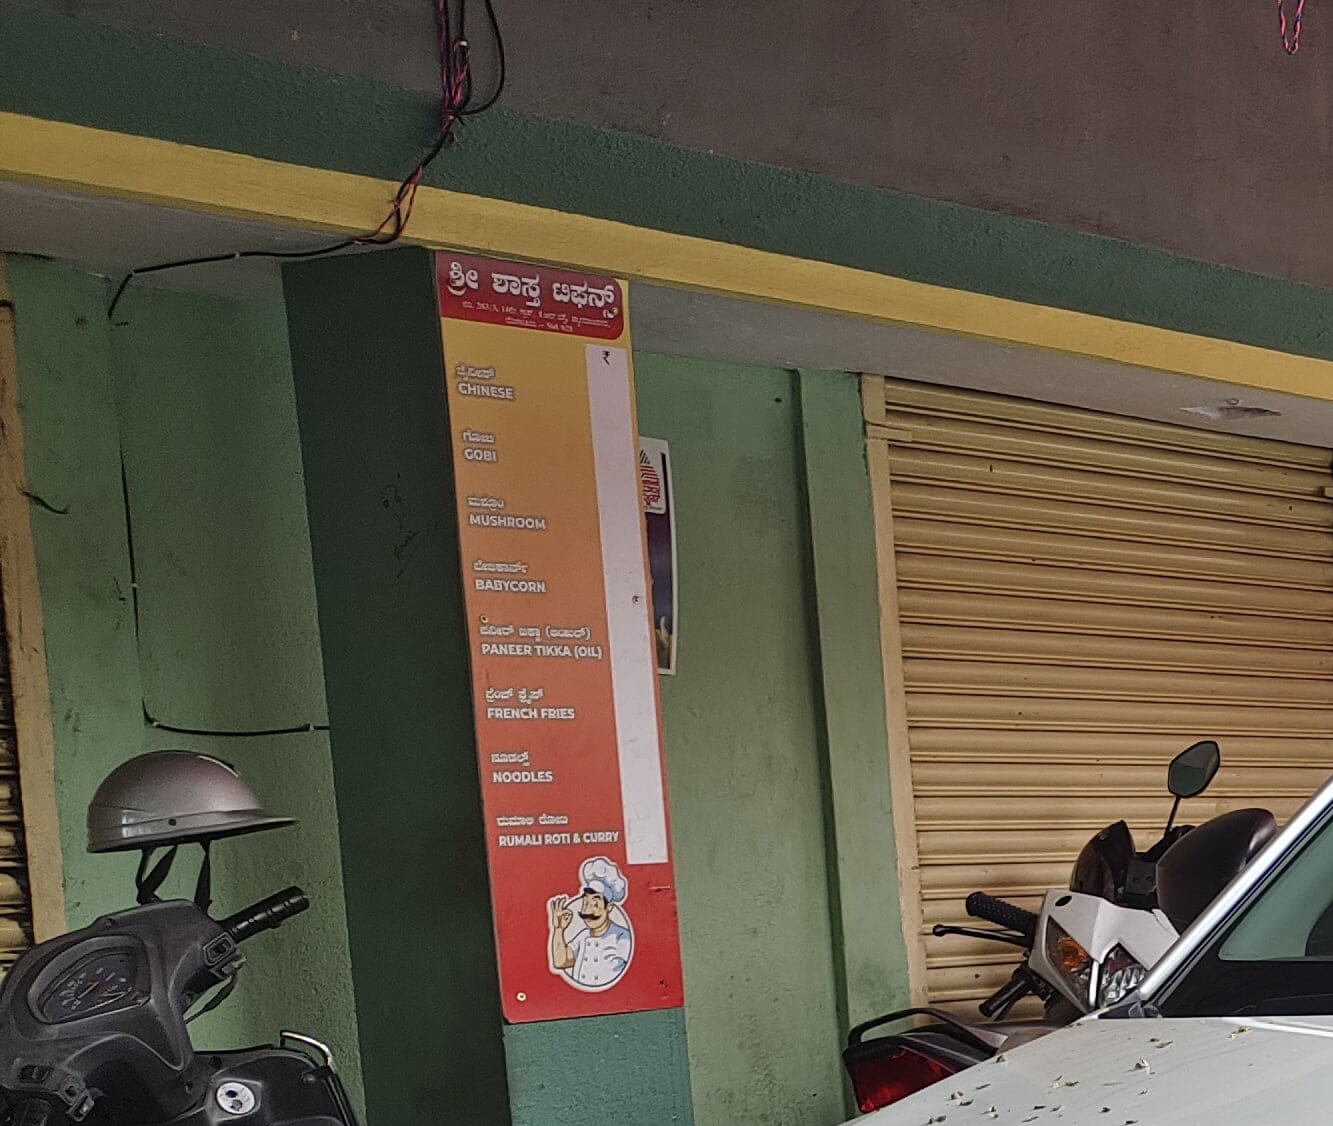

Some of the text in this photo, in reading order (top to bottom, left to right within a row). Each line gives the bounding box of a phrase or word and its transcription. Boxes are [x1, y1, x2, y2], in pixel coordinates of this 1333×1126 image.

[447, 261, 480, 296] ಶ್ರೀ
[458, 383, 514, 399] CHINESE
[464, 449, 497, 462] GOBI
[469, 514, 546, 530] MUSHROOM
[475, 579, 546, 593] BABYCORN
[481, 643, 532, 656] PANEER
[534, 645, 572, 657] TIKKA
[487, 707, 576, 720] FRENCH FRIES
[492, 771, 553, 783] NOODLES
[498, 831, 620, 847] RUMALI ROTI & CURRY
